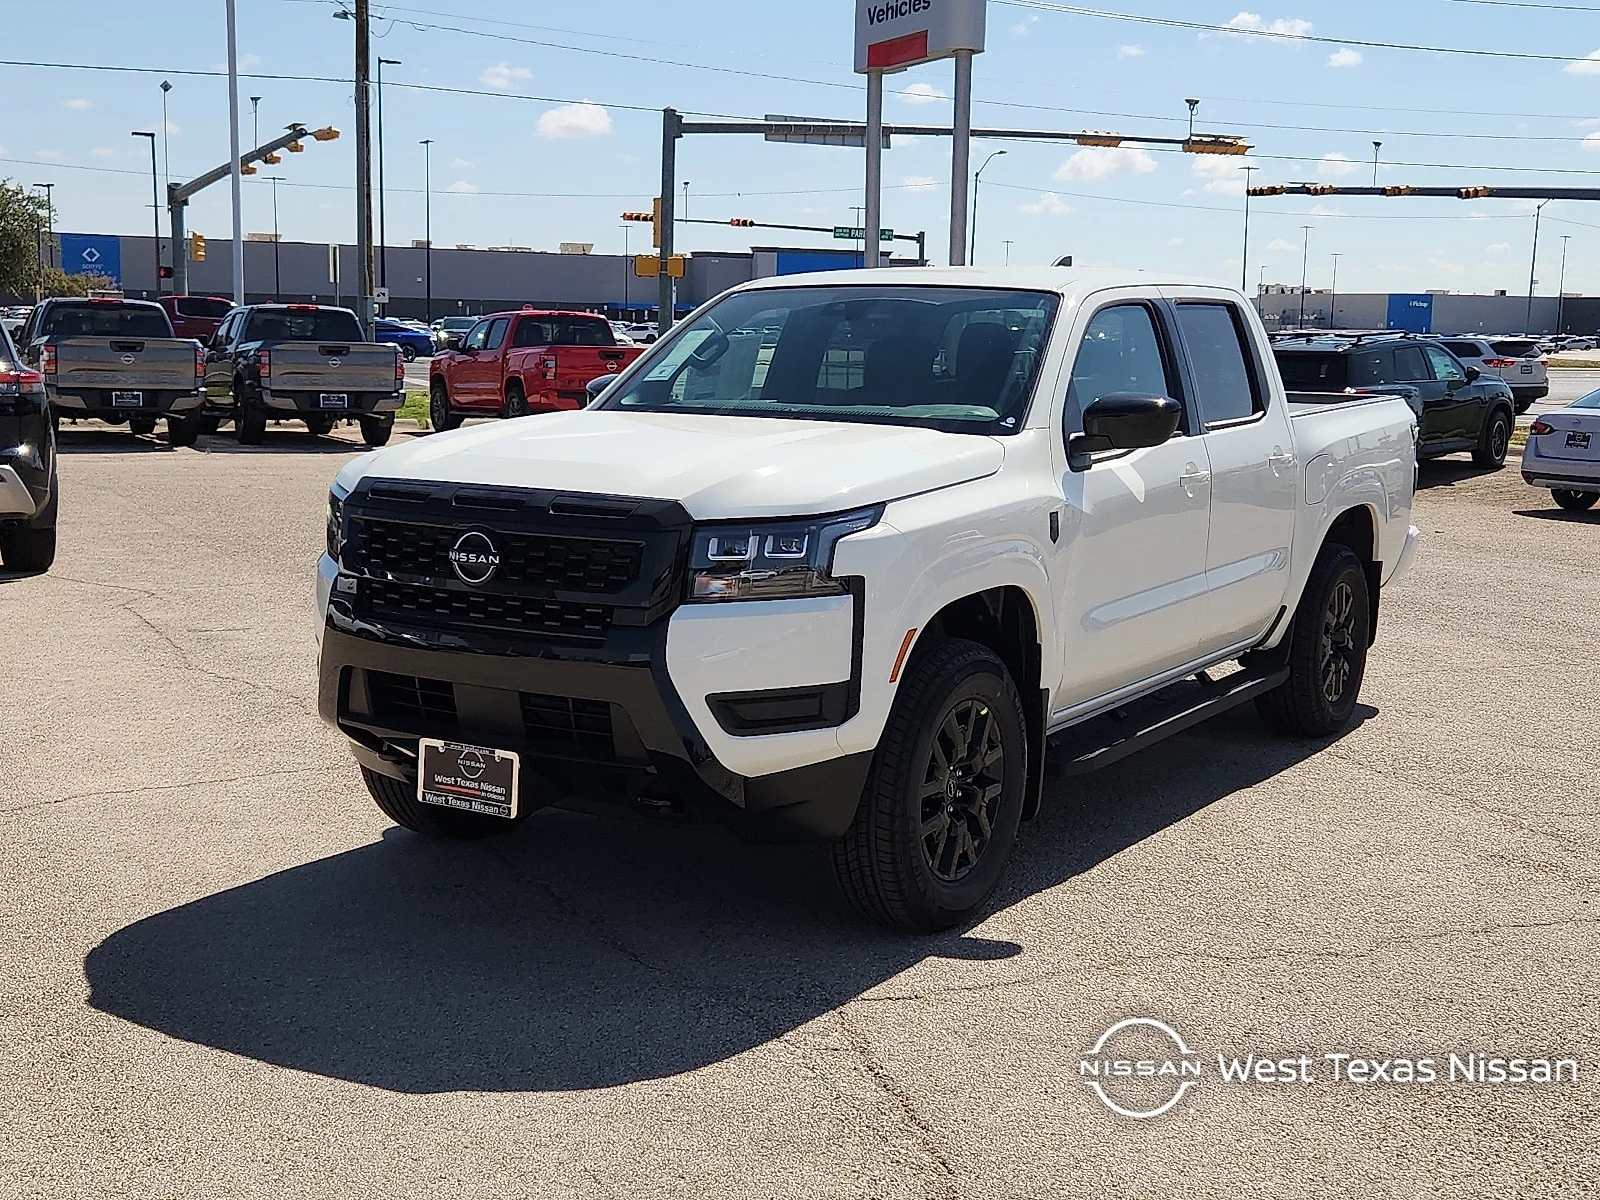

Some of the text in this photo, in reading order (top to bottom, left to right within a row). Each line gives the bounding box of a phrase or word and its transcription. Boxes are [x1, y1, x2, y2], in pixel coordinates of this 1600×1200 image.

[867, 0, 931, 26] Vehicles
[850, 228, 865, 238] PAR
[448, 550, 500, 564] NISSAN
[457, 758, 486, 769] NISSAN
[434, 773, 506, 794] West Texas Nissan
[425, 793, 499, 814] West Texas Nissan
[487, 792, 506, 801] Odessa
